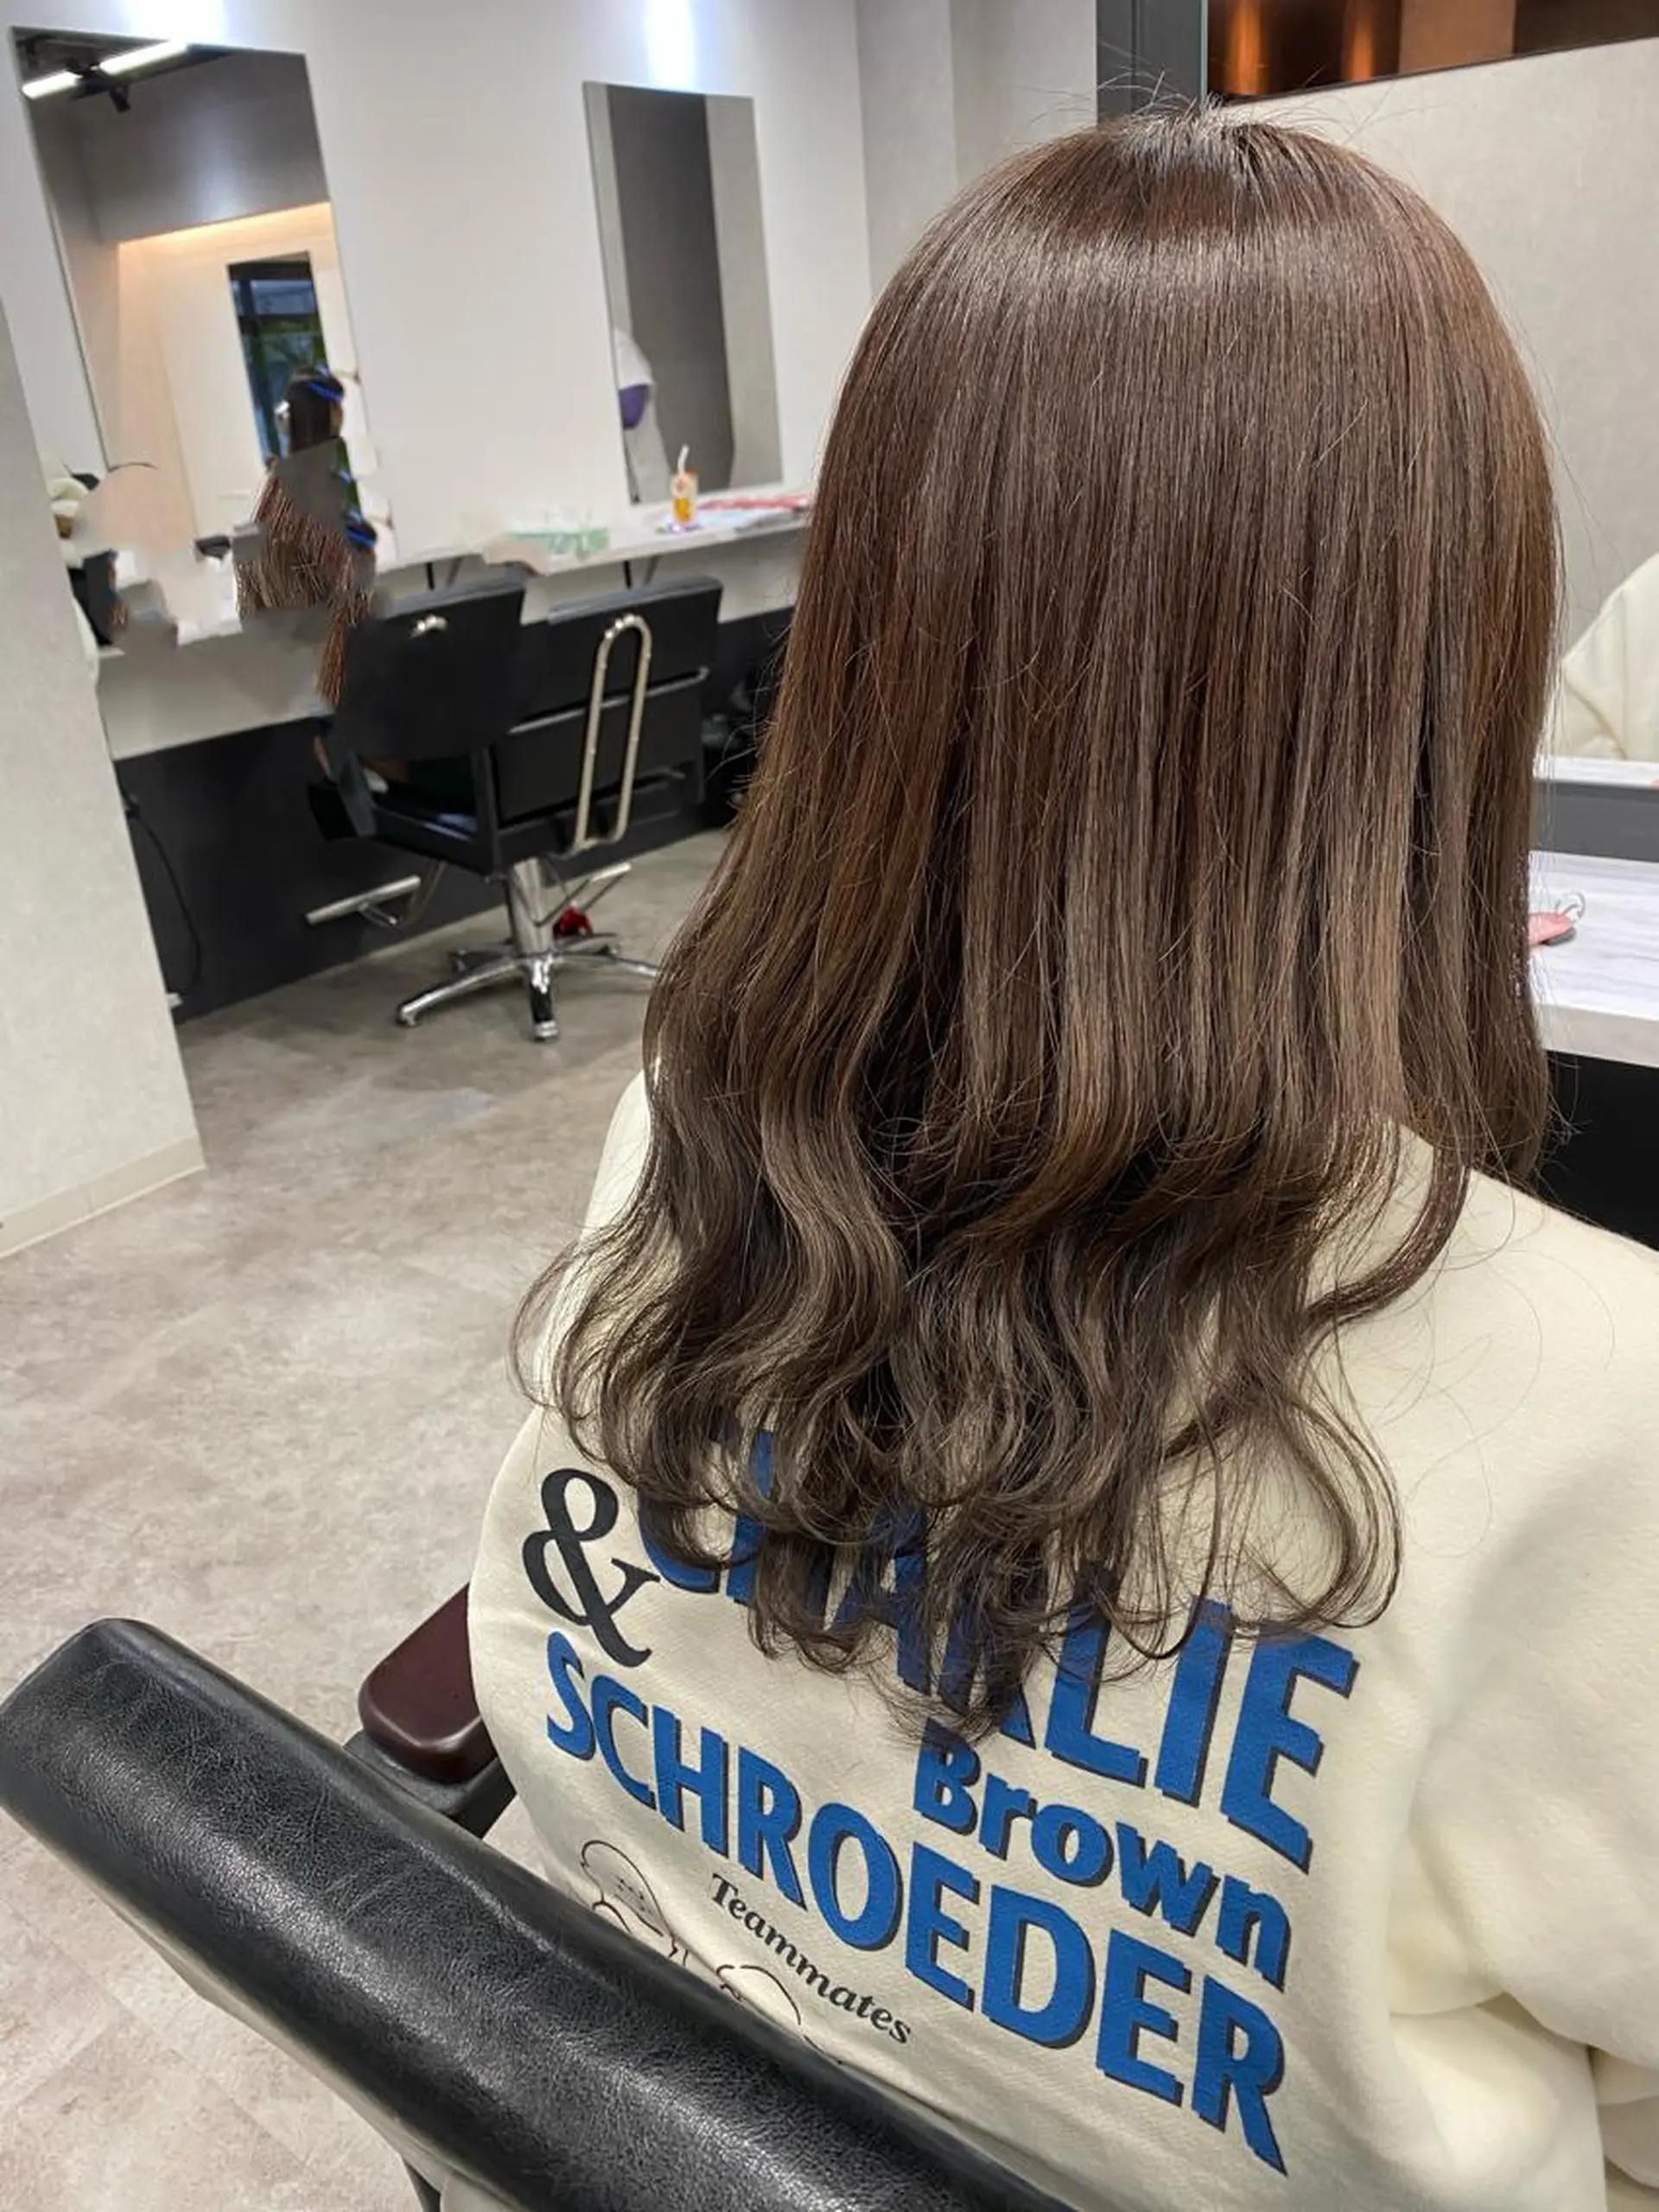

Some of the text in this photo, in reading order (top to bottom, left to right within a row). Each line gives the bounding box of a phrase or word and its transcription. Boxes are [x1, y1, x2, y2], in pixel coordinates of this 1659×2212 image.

[521, 1468, 662, 1667] &
[544, 1630, 1288, 2177] SCHROEDER
[712, 1873, 912, 2044] Teammates
[913, 1716, 1290, 1992] Brown
